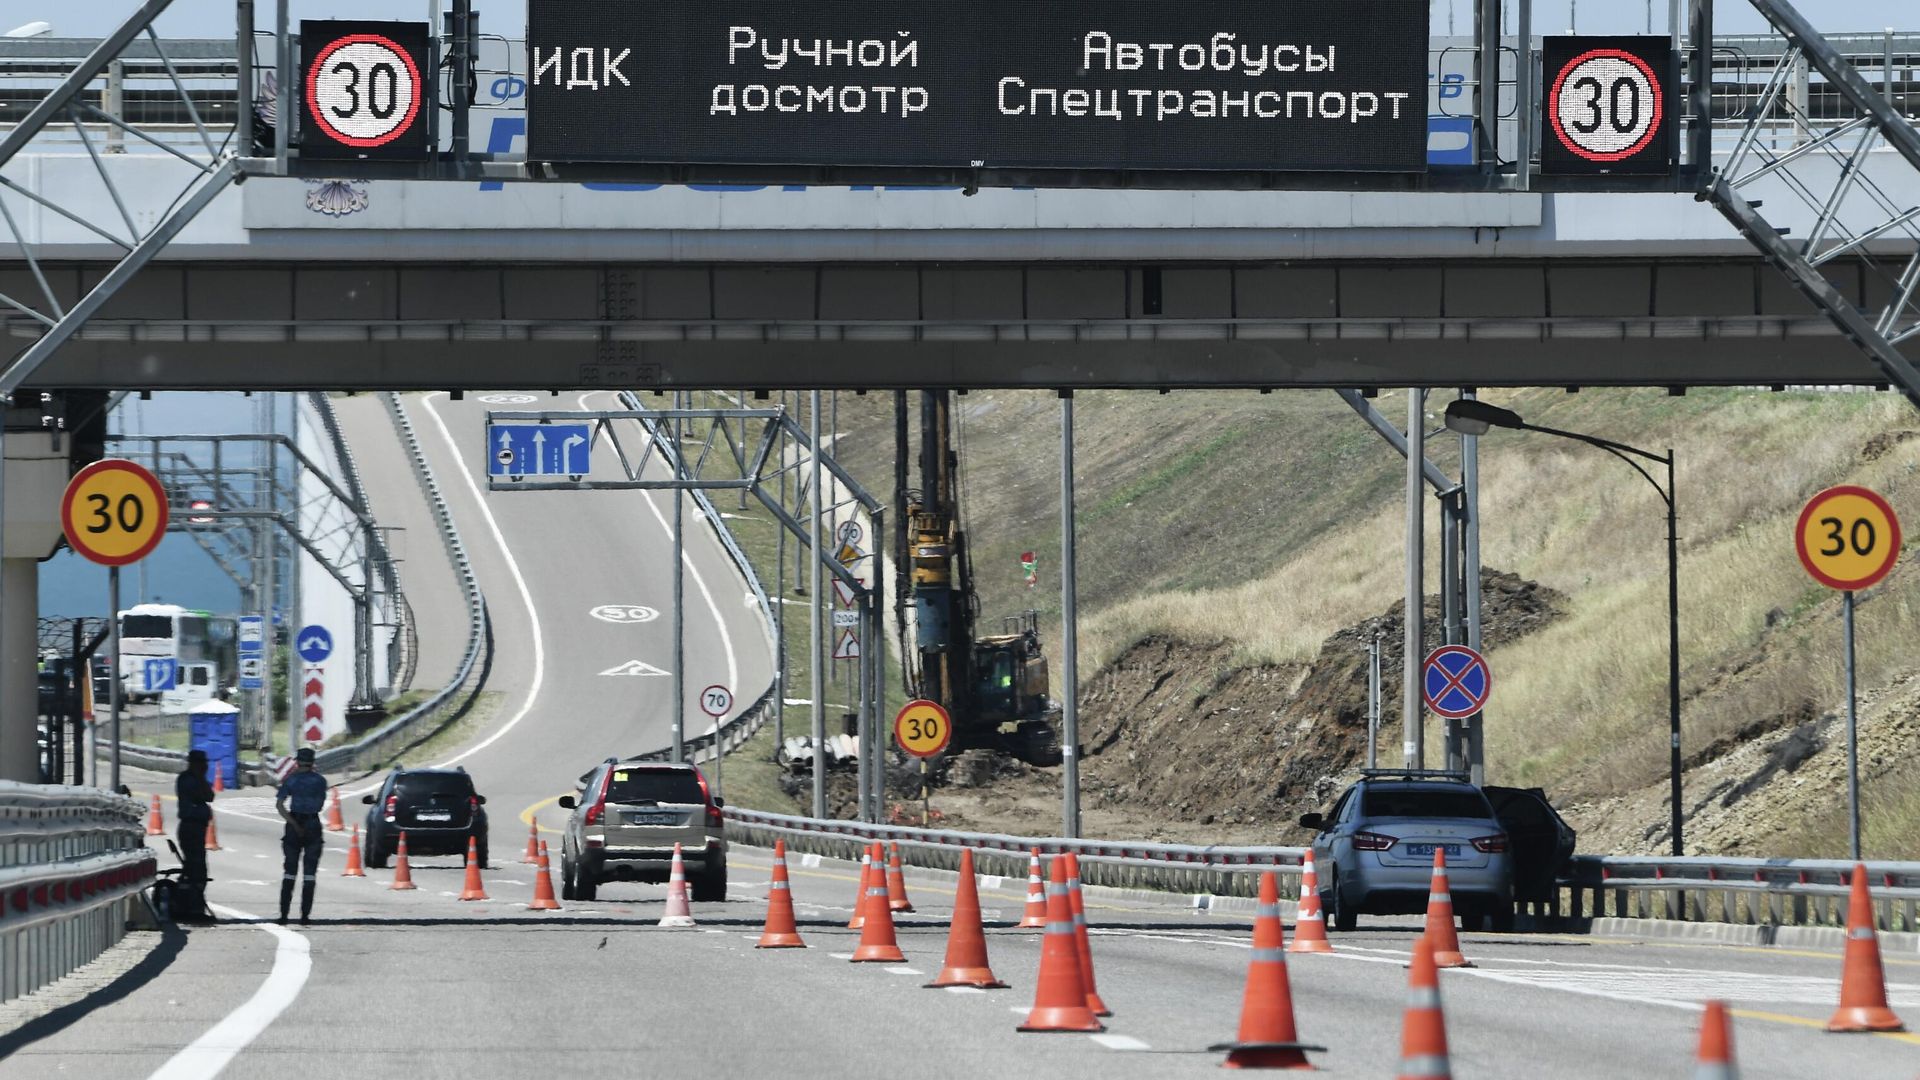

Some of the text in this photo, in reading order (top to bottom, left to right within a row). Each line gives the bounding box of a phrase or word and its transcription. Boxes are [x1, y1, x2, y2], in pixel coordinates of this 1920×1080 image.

[533, 46, 631, 90] ИДК
[728, 27, 918, 69] Ручной
[1083, 31, 1335, 76] Автобусы
[331, 61, 399, 119] 30
[709, 85, 929, 117] досмотр
[998, 77, 1408, 123] Спецтранспорт
[1572, 77, 1640, 133] 30
[87, 493, 143, 533] 30
[1821, 517, 1876, 556] 30
[602, 608, 650, 619] 50
[707, 693, 725, 707] 70
[908, 718, 937, 740] 30
